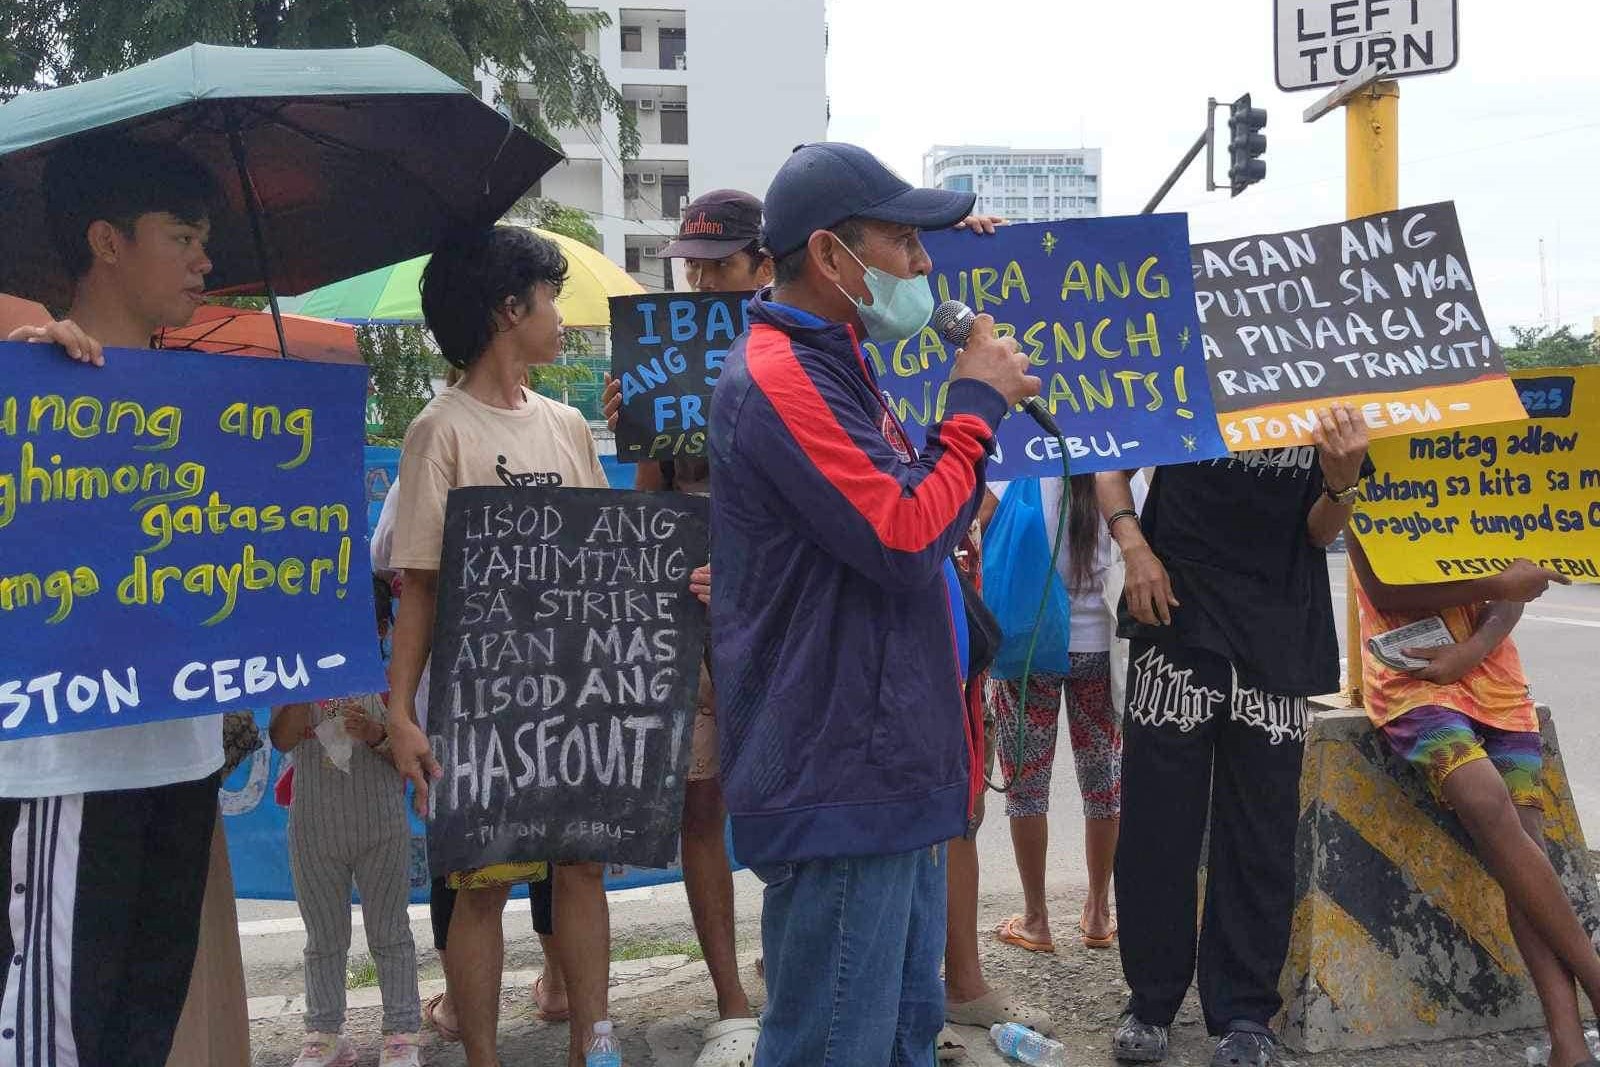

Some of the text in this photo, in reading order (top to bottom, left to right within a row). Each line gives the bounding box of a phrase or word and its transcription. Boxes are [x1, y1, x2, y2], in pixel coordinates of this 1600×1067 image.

[1299, 30, 1433, 82] TURN
[1342, 213, 1438, 264] ANG
[1061, 257, 1171, 303] ANG
[1194, 253, 1473, 323] PUTOL SA MGA
[1236, 307, 1425, 356] PINAAGI
[1435, 301, 1482, 335] SA
[621, 346, 688, 406] ANG
[1217, 335, 1491, 396] RAPID TRANSIT!
[219, 401, 314, 470] ang
[1409, 425, 1579, 467] matag adlaw
[1446, 476, 1471, 496] sa
[1480, 469, 1531, 497] kita
[1546, 469, 1570, 491] sa
[133, 491, 349, 554] gatasan
[463, 503, 689, 543] LISOD ANG
[1352, 511, 1459, 541] Drayber
[1470, 504, 1554, 541] tungod
[1555, 509, 1585, 532] sa
[0, 536, 351, 627] mga drayber!
[458, 544, 688, 589] KAHIMTANG
[459, 587, 680, 625] SA STRIKE
[450, 624, 680, 674] APAN MAS
[450, 664, 681, 722] LISOD ANG
